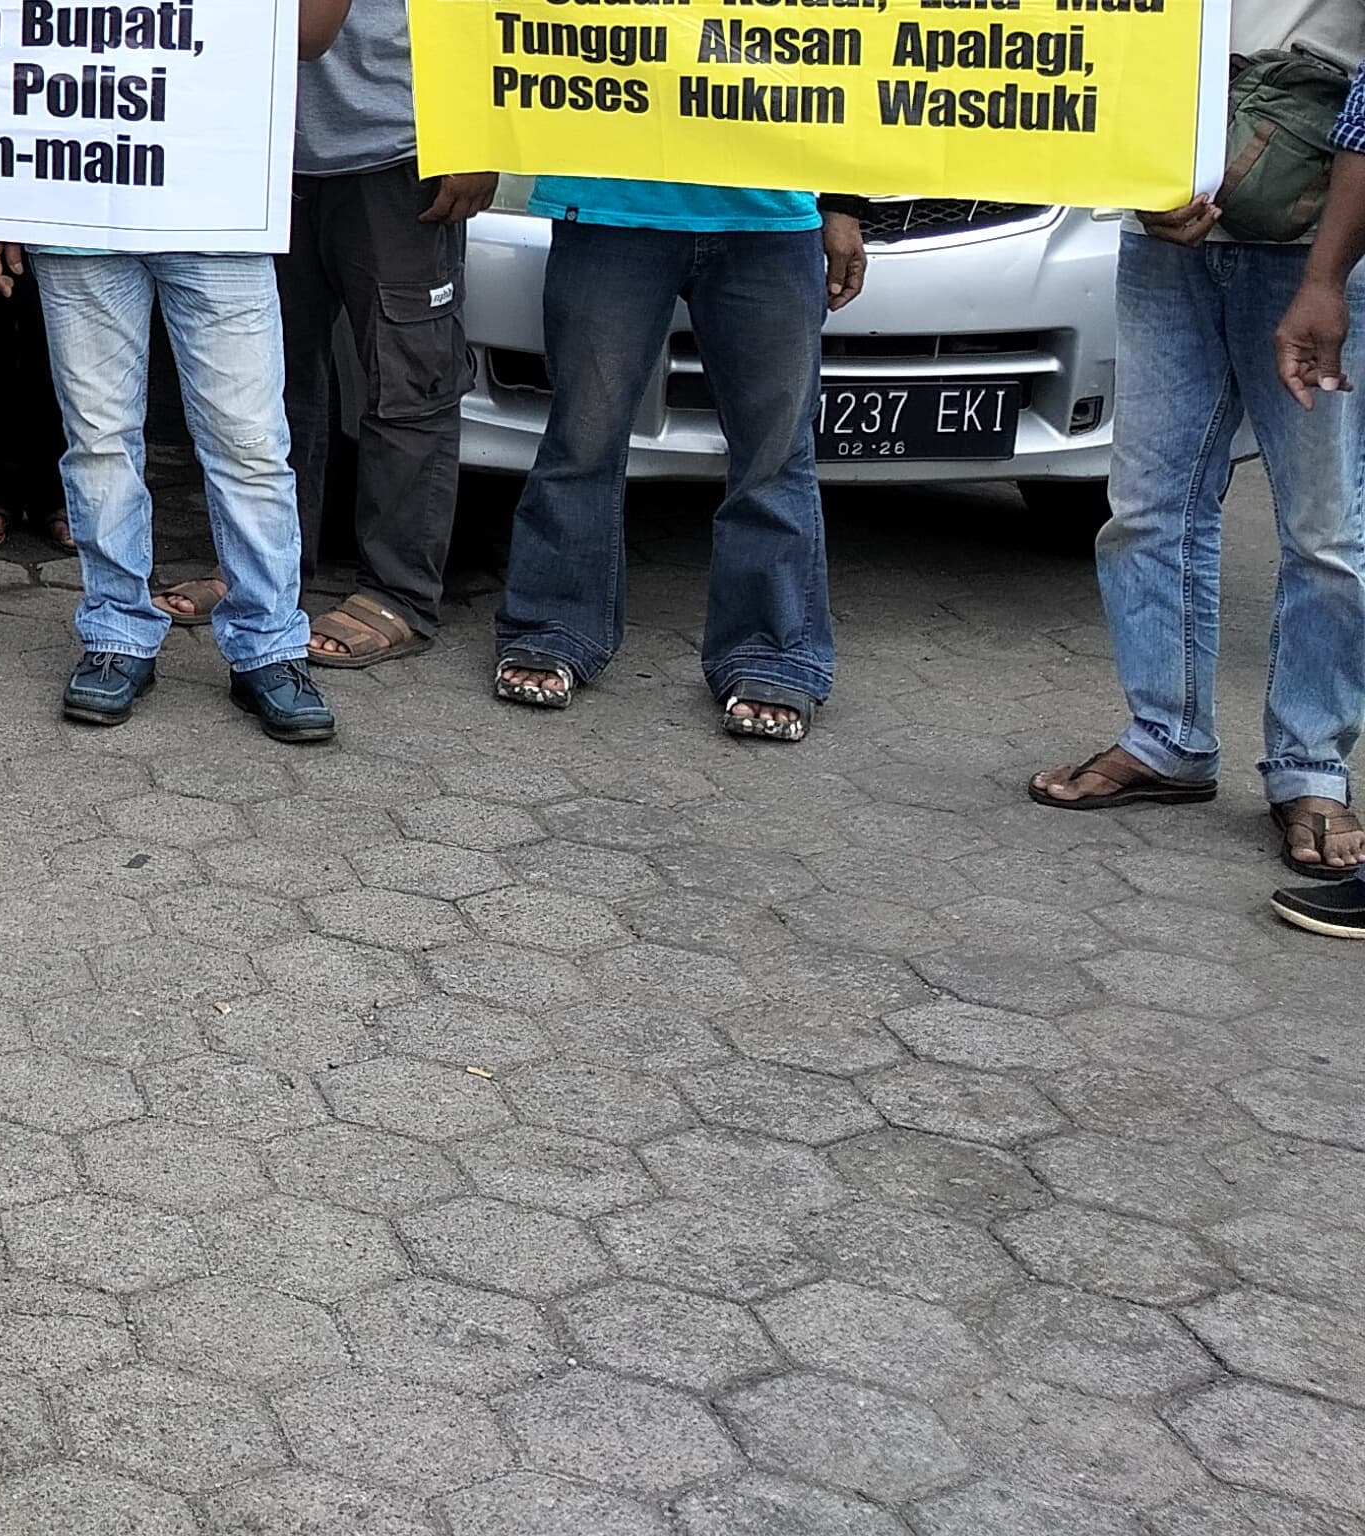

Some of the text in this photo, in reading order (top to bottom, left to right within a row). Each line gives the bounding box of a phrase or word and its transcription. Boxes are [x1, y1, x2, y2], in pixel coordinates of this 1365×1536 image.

[495, 11, 1094, 77] Tunggu Alasan Apalagi,
[13, 62, 167, 122] Polisi
[492, 65, 1097, 133] Proses Hukum Wasduki
[819, 390, 1006, 434] 1237 EKI
